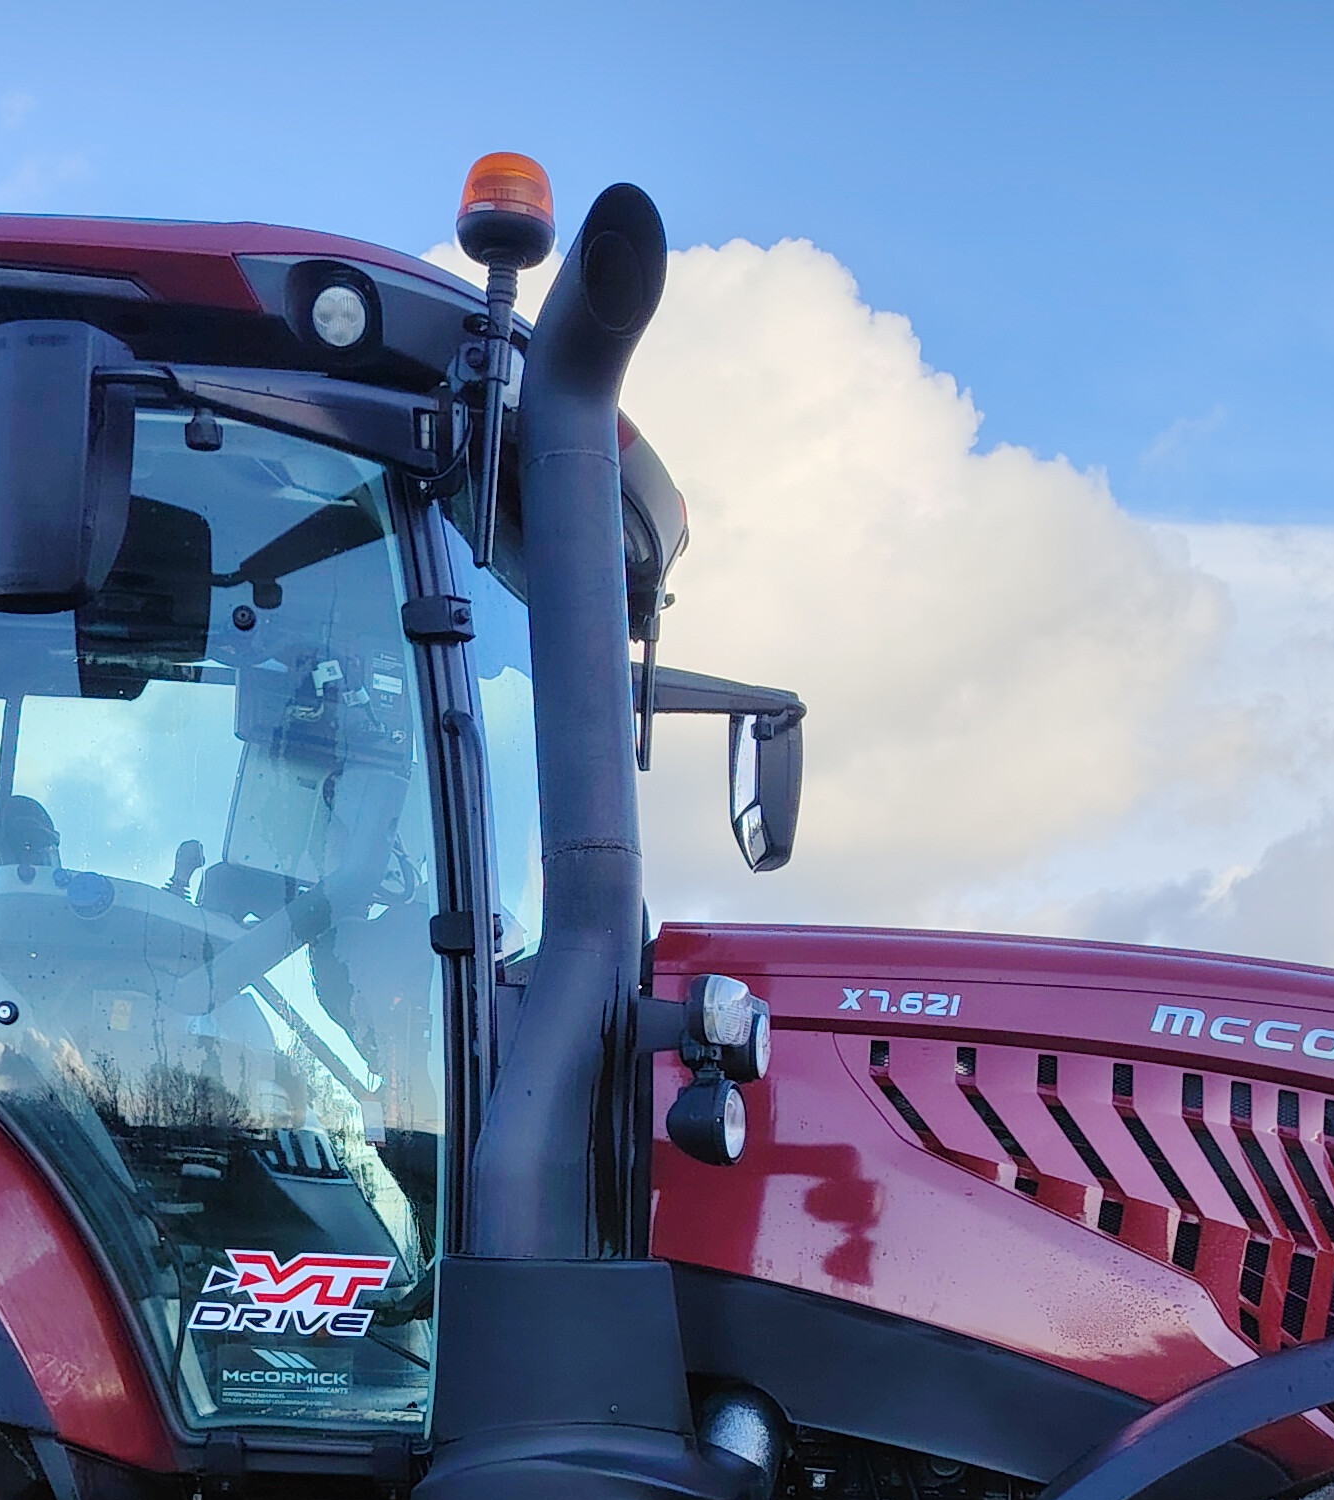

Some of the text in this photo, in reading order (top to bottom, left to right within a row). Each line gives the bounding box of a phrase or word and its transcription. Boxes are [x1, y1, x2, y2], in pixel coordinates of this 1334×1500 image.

[233, 1252, 393, 1307] VT
[192, 1303, 370, 1335] DRIVE
[221, 1369, 349, 1385] McCORMICK
